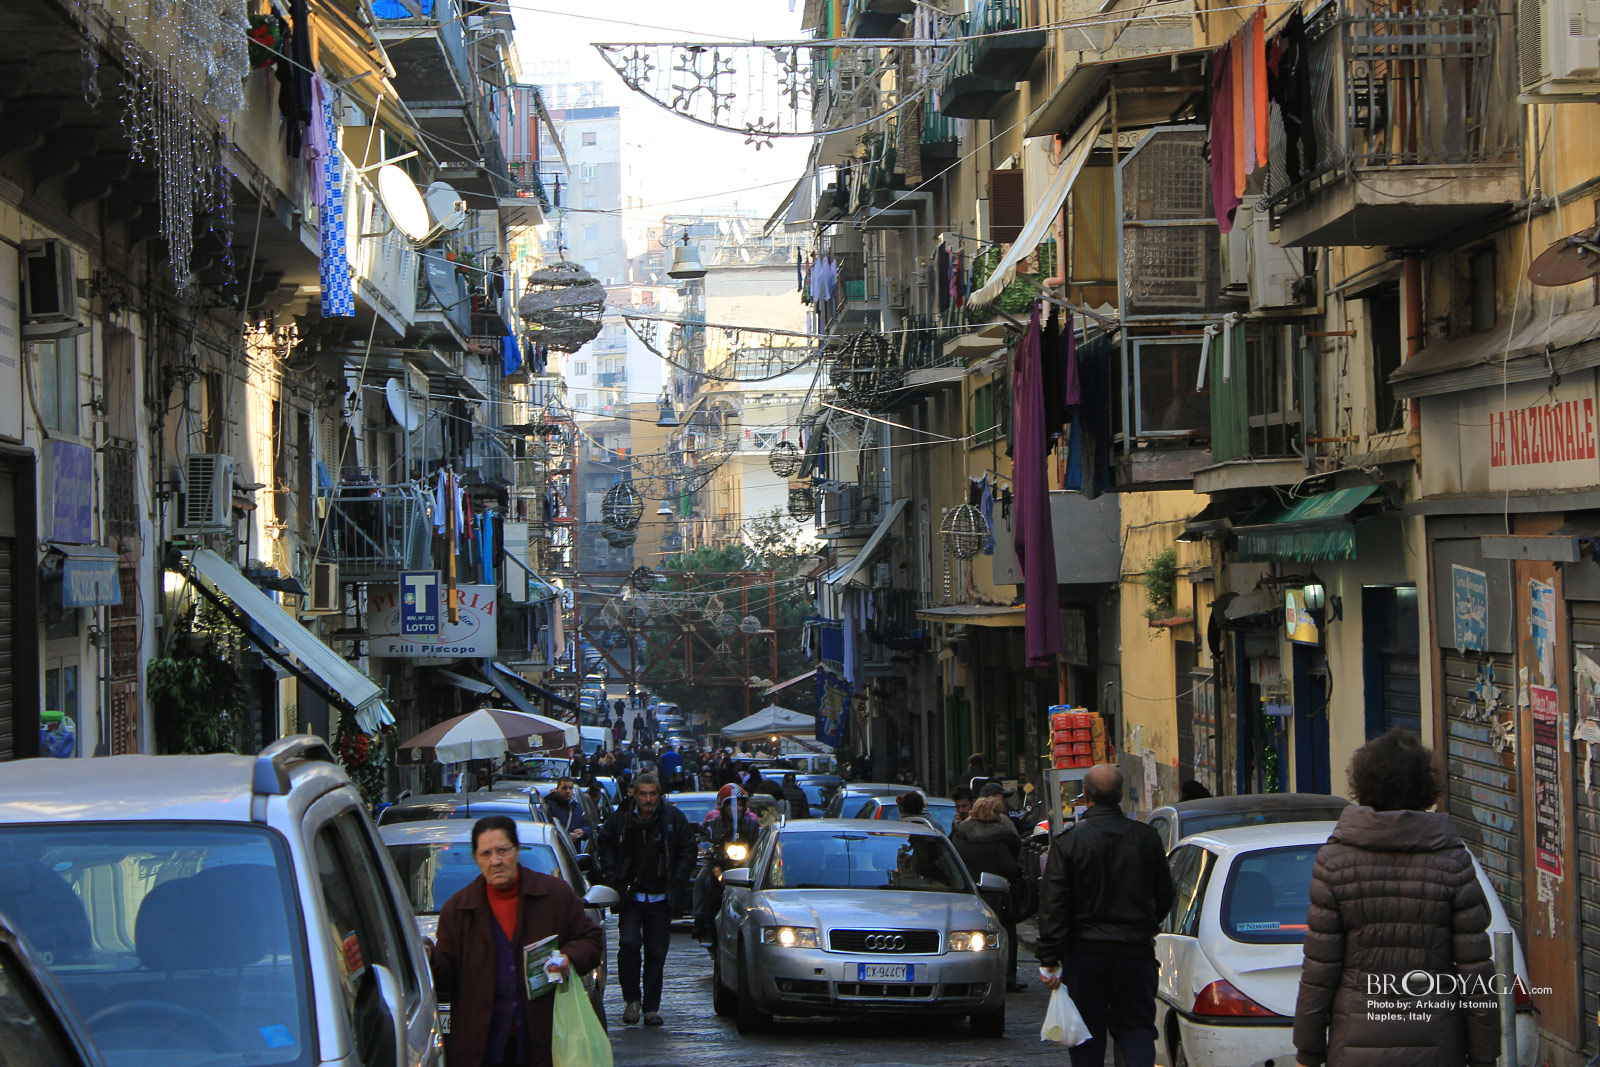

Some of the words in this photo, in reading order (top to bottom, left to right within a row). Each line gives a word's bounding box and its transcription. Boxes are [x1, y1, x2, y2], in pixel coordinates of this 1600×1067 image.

[1489, 411, 1507, 467] LA
[1509, 398, 1596, 466] NAZIONALE
[405, 575, 436, 613] T
[406, 623, 436, 632] LOTTO
[422, 645, 476, 655] Piscopo
